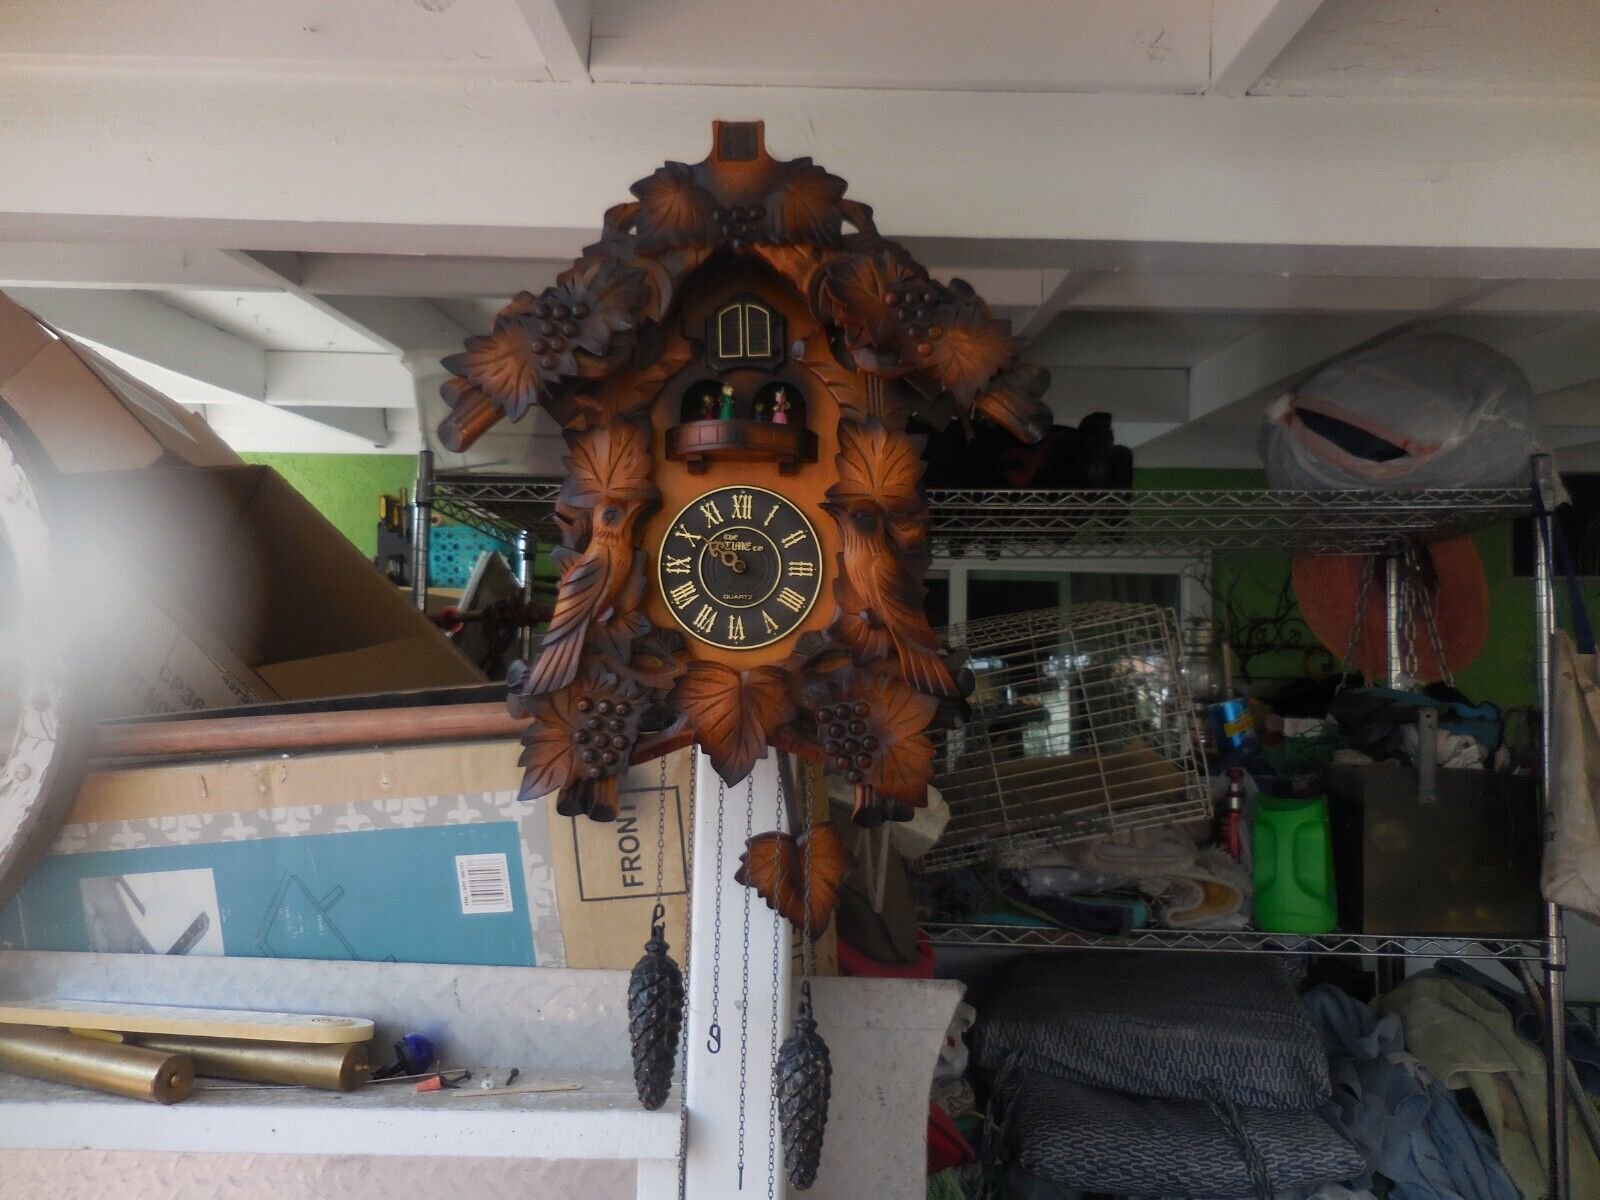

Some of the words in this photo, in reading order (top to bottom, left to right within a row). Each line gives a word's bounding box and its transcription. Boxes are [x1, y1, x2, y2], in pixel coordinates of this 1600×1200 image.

[700, 501, 724, 528] XI
[732, 494, 752, 519] XII
[763, 504, 779, 526] I
[675, 523, 701, 547] X
[781, 530, 807, 548] II
[666, 555, 692, 573] IX
[788, 561, 814, 577] III
[670, 580, 700, 610] VIII
[776, 586, 806, 613] IIII
[693, 603, 718, 633] VII
[728, 614, 746, 641] VI
[761, 610, 779, 634] V
